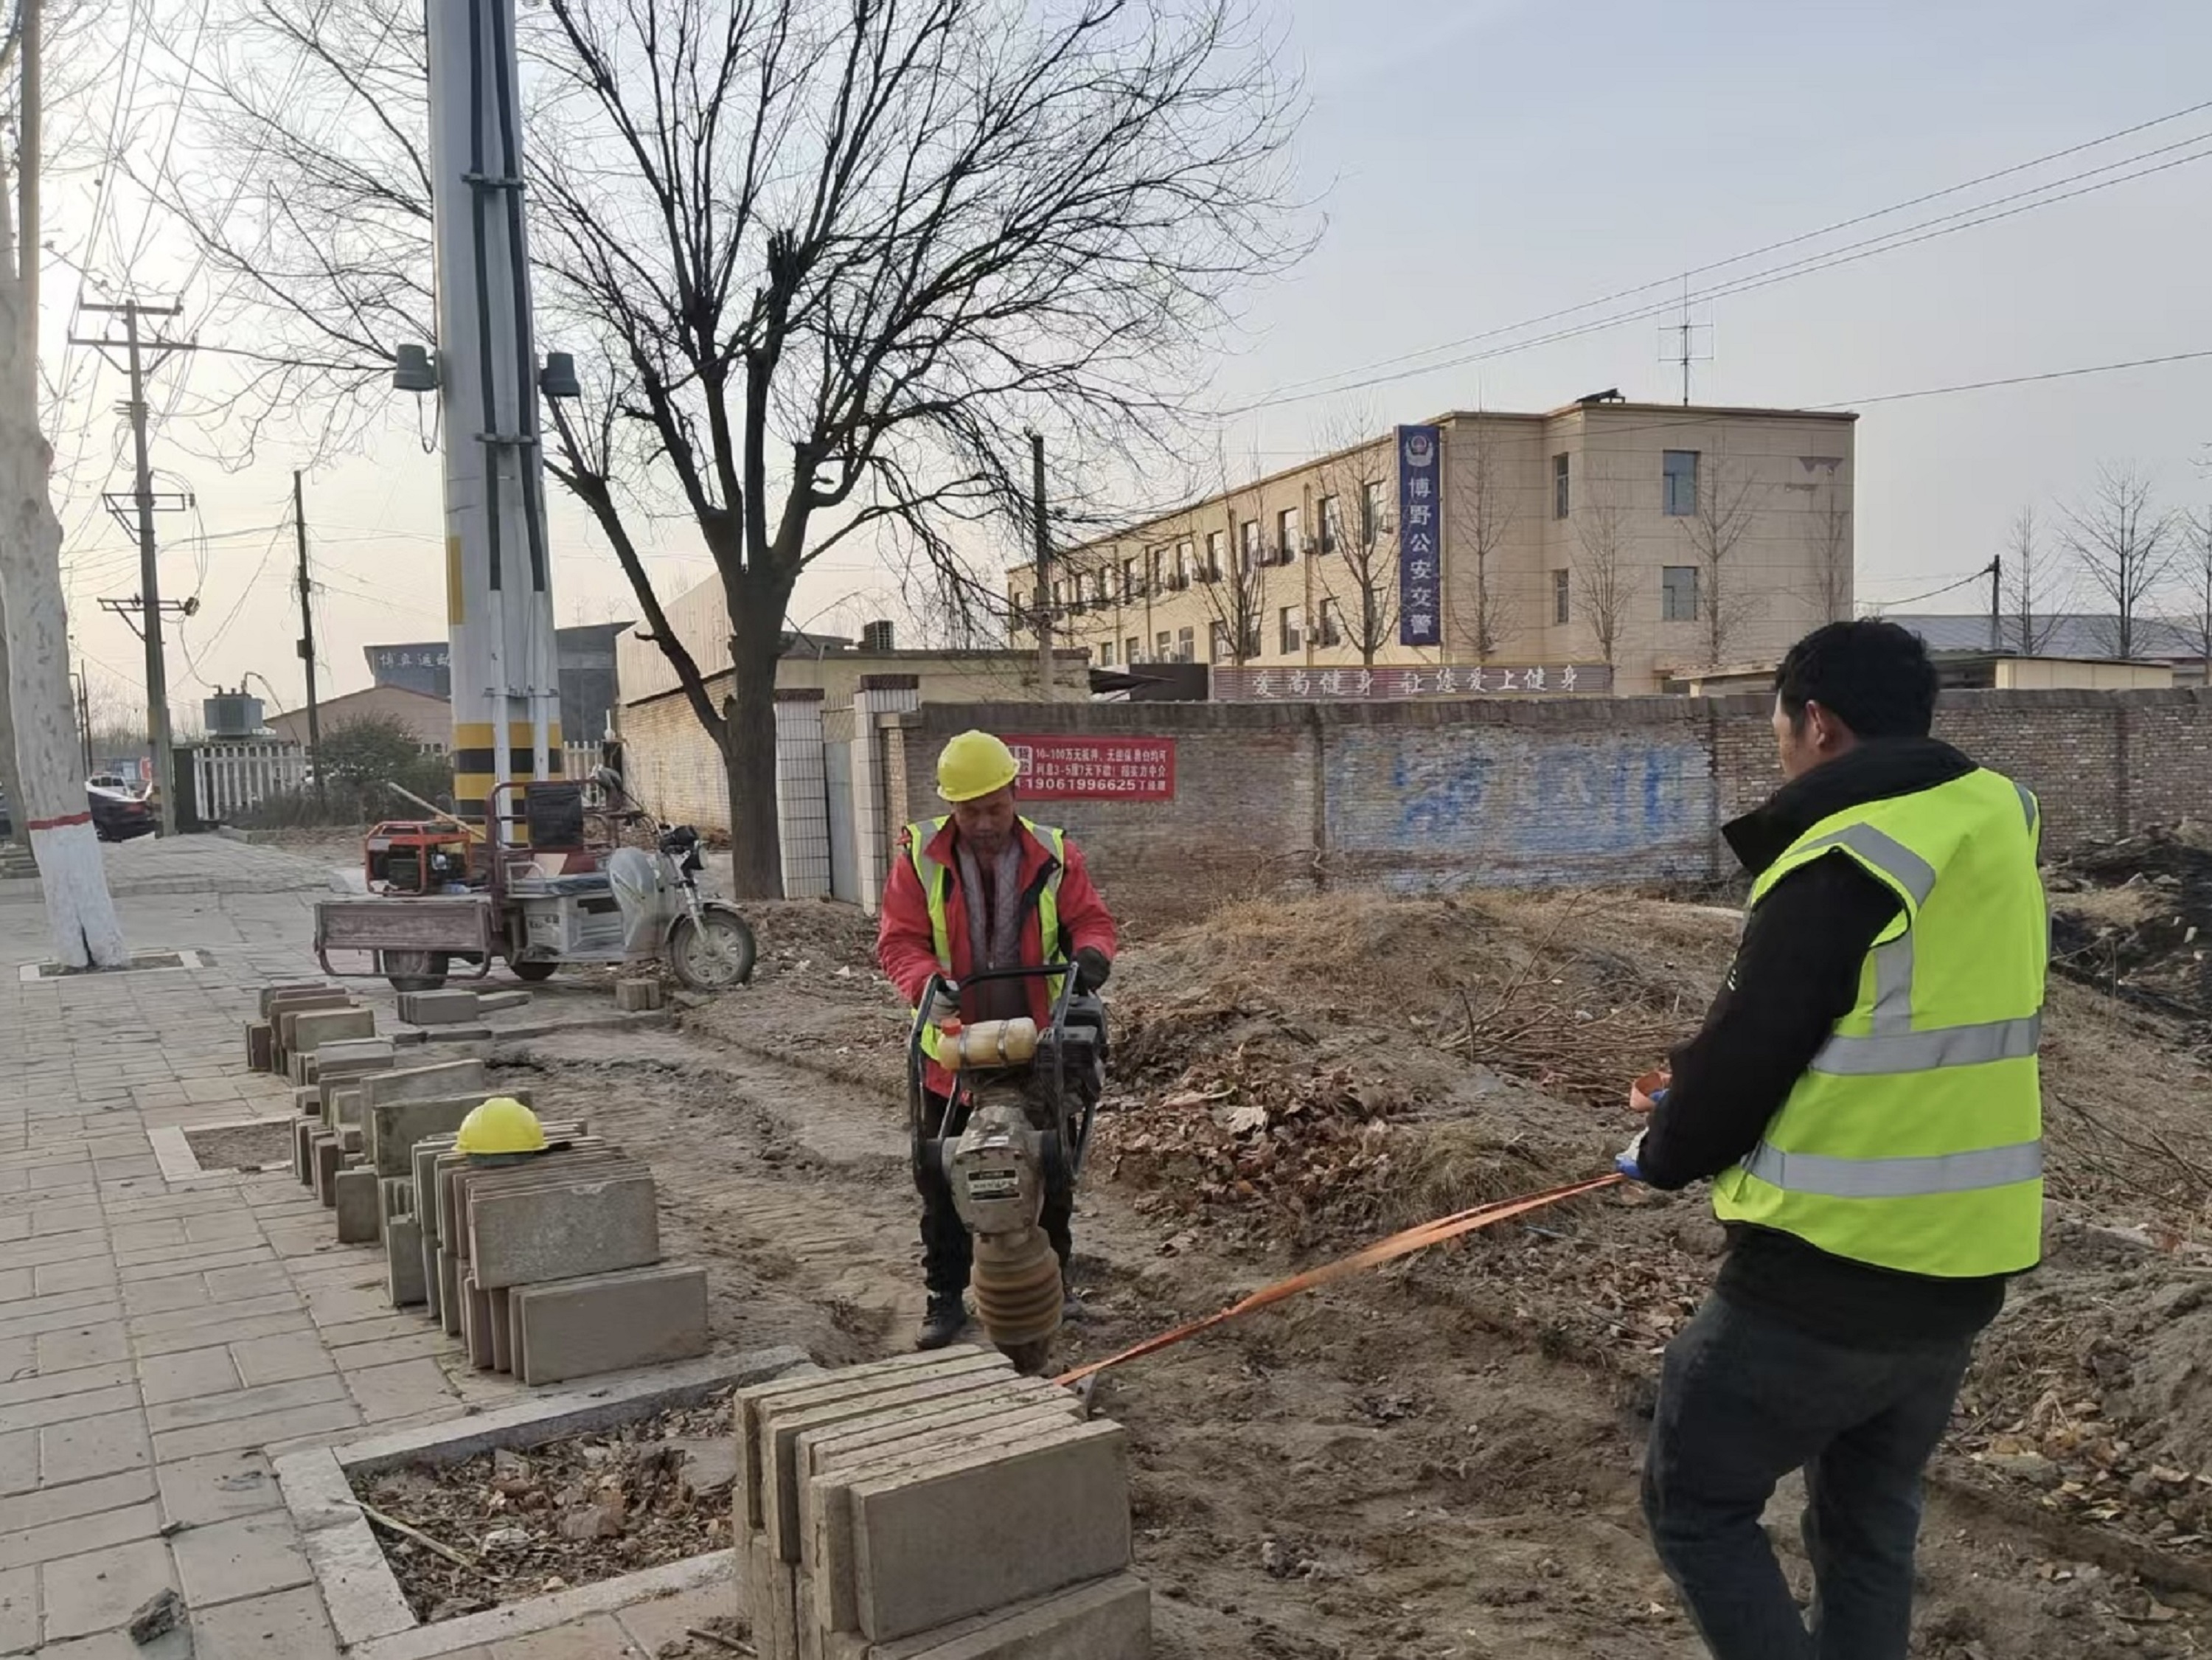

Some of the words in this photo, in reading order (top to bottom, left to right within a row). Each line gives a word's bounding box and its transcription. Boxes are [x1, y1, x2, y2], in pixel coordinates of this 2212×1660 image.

[1408, 478, 1432, 635] 博野公安交警
[1253, 669, 1374, 698] 爱尚健身
[1400, 664, 1577, 694] 让您爱上健身
